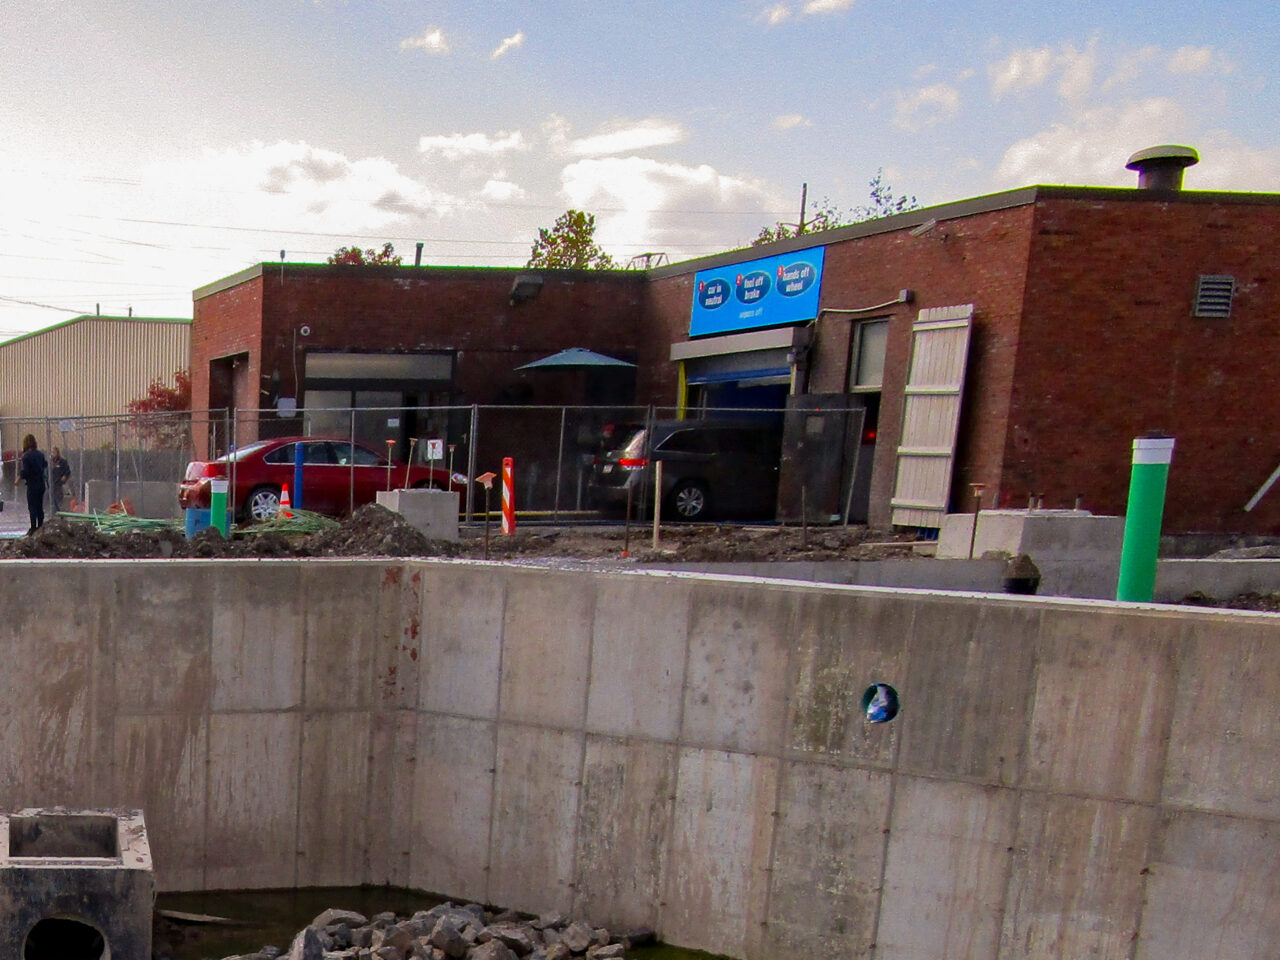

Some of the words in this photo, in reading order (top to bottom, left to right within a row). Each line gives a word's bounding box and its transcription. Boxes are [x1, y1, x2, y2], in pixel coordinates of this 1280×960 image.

[783, 269, 800, 281] hands
[800, 266, 810, 278] off
[755, 276, 764, 287] off
[786, 280, 804, 292] wheel
